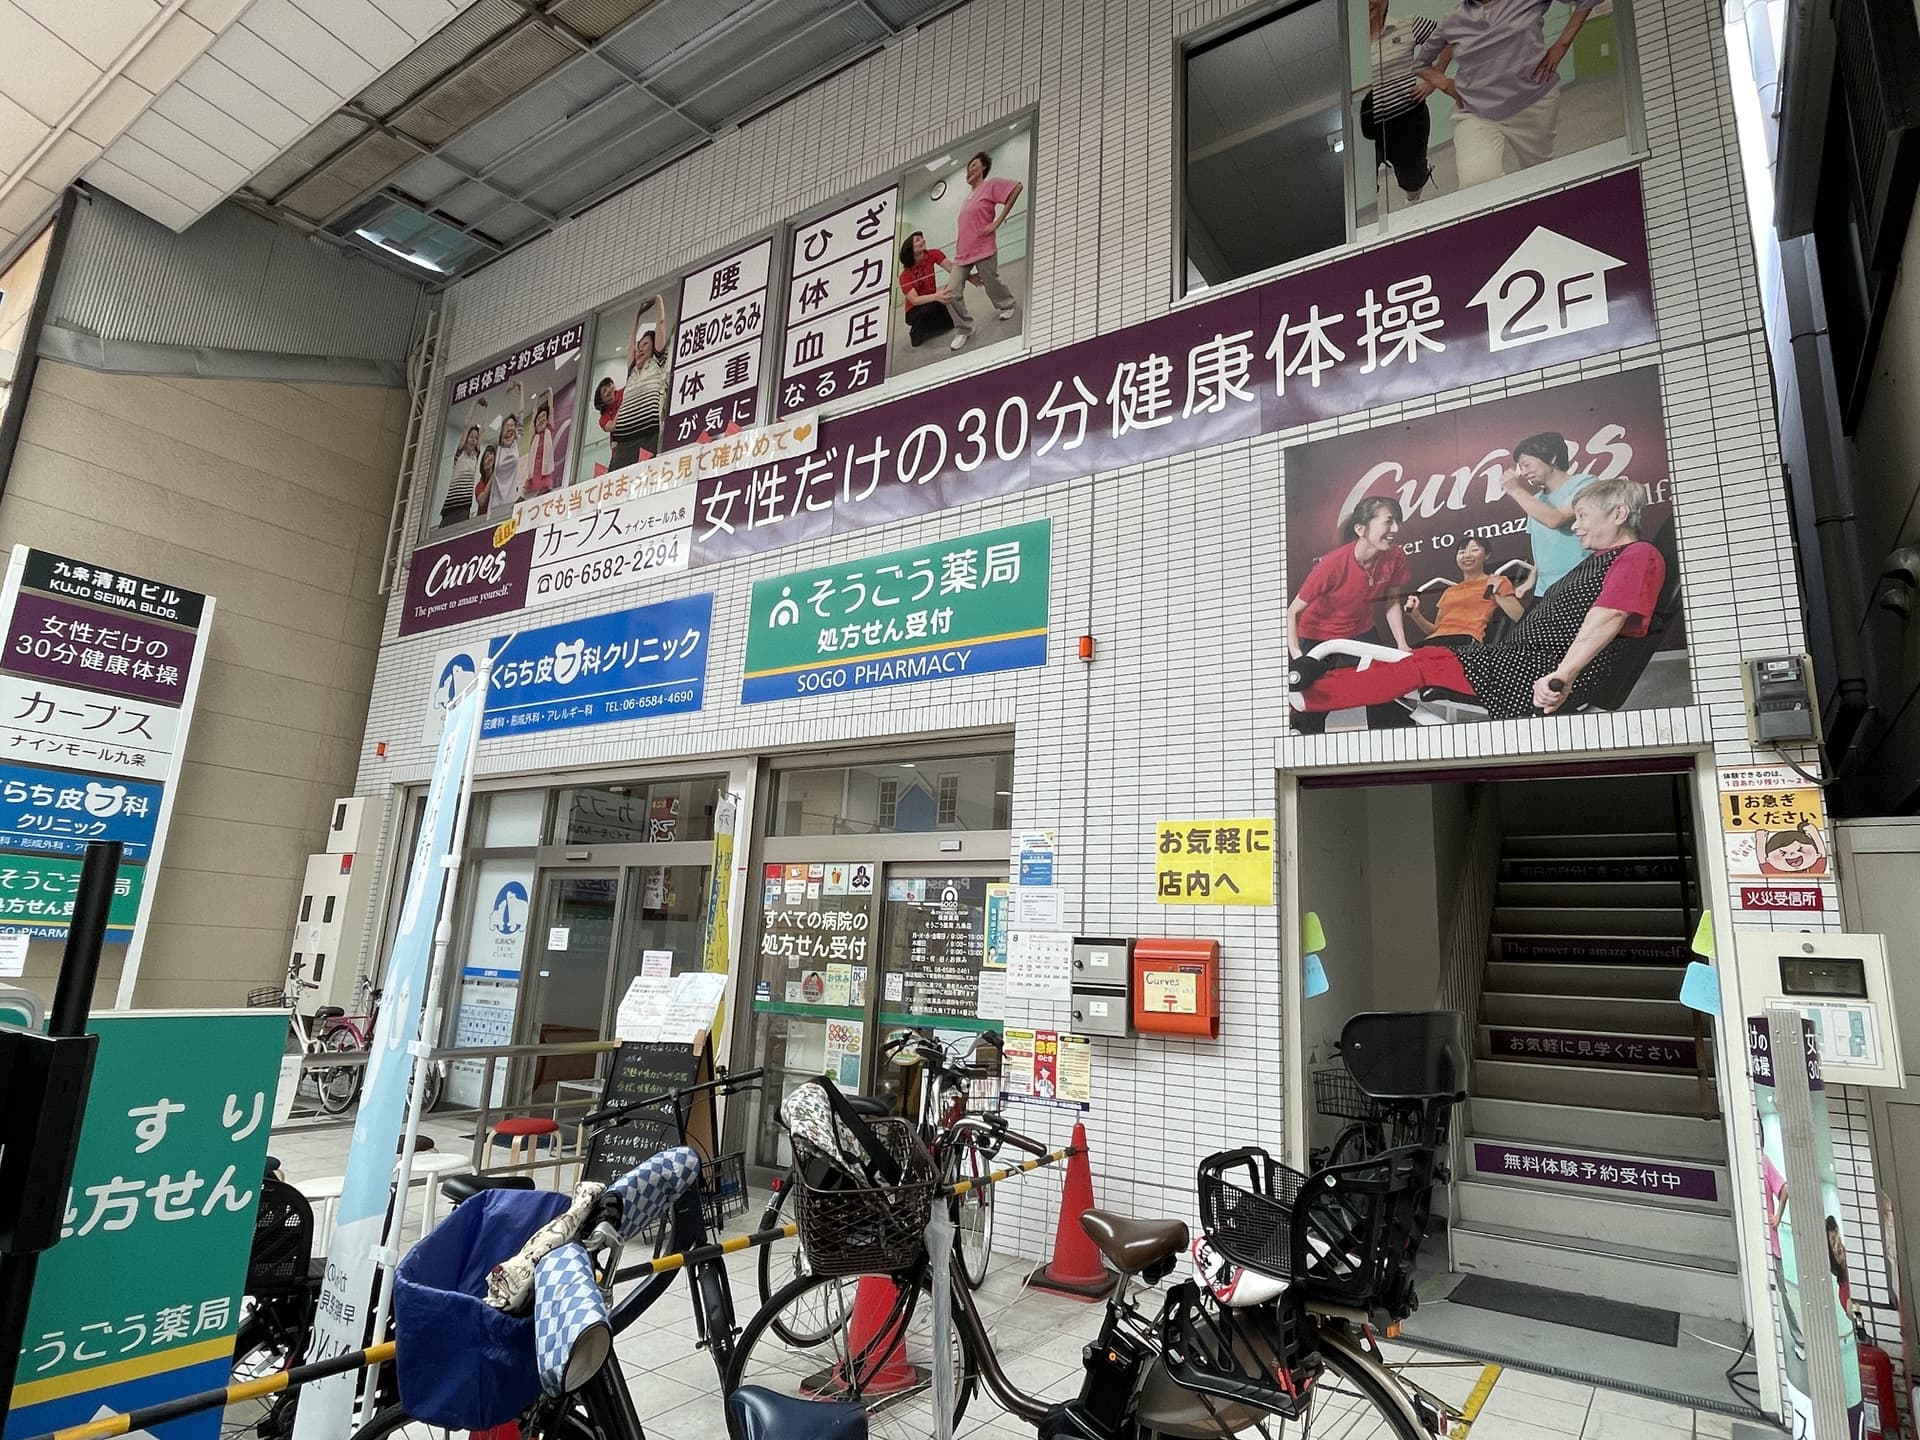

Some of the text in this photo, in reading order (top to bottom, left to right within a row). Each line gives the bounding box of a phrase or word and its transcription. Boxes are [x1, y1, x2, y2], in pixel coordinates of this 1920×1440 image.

[803, 201, 887, 261] ひざ
[710, 261, 742, 301] 腰
[799, 258, 883, 315] 体力
[679, 301, 761, 358] お腹のたるみ
[793, 306, 880, 367] 血圧
[679, 352, 751, 405] 体重
[784, 359, 872, 408] なる方
[677, 398, 751, 441] が気に
[699, 270, 1595, 543] 女性だけの30分健康体操 2F
[539, 508, 622, 559] カーブス
[1432, 533, 1454, 548] to
[54, 562, 180, 605] 九条清和ビル
[425, 550, 507, 598] Curves
[555, 540, 679, 591] 06-6582-2294
[807, 541, 1021, 618] そうごう薬局
[50, 578, 178, 620] KUJO SEIWA BLDG.
[40, 615, 168, 659] 女性だけの
[816, 607, 953, 654] 処方せん受付
[16, 635, 179, 686] 30分健康体操
[491, 628, 700, 690] くらち皮フ科クリニック
[797, 650, 971, 693] SOGO PHARMACY
[13, 691, 153, 740] カーブス
[11, 735, 147, 767] ナインモール九条
[0, 779, 149, 818] らち皮フ科
[1745, 793, 1796, 808] お急ぎ
[1748, 811, 1817, 825] ください
[16, 813, 108, 836] クリニック
[1160, 827, 1270, 854] お気軽に
[1158, 870, 1240, 897] 店内へ
[1747, 890, 1816, 907] 火災受信所
[764, 909, 868, 930] すべての病院の
[761, 933, 867, 961] 処方せん受付
[1146, 972, 1180, 986] Curves
[1510, 1037, 1680, 1061] お気軽に見学ください
[1503, 1153, 1681, 1190] 無料体験予約受付中
[20, 1297, 231, 1372] うごう薬局
